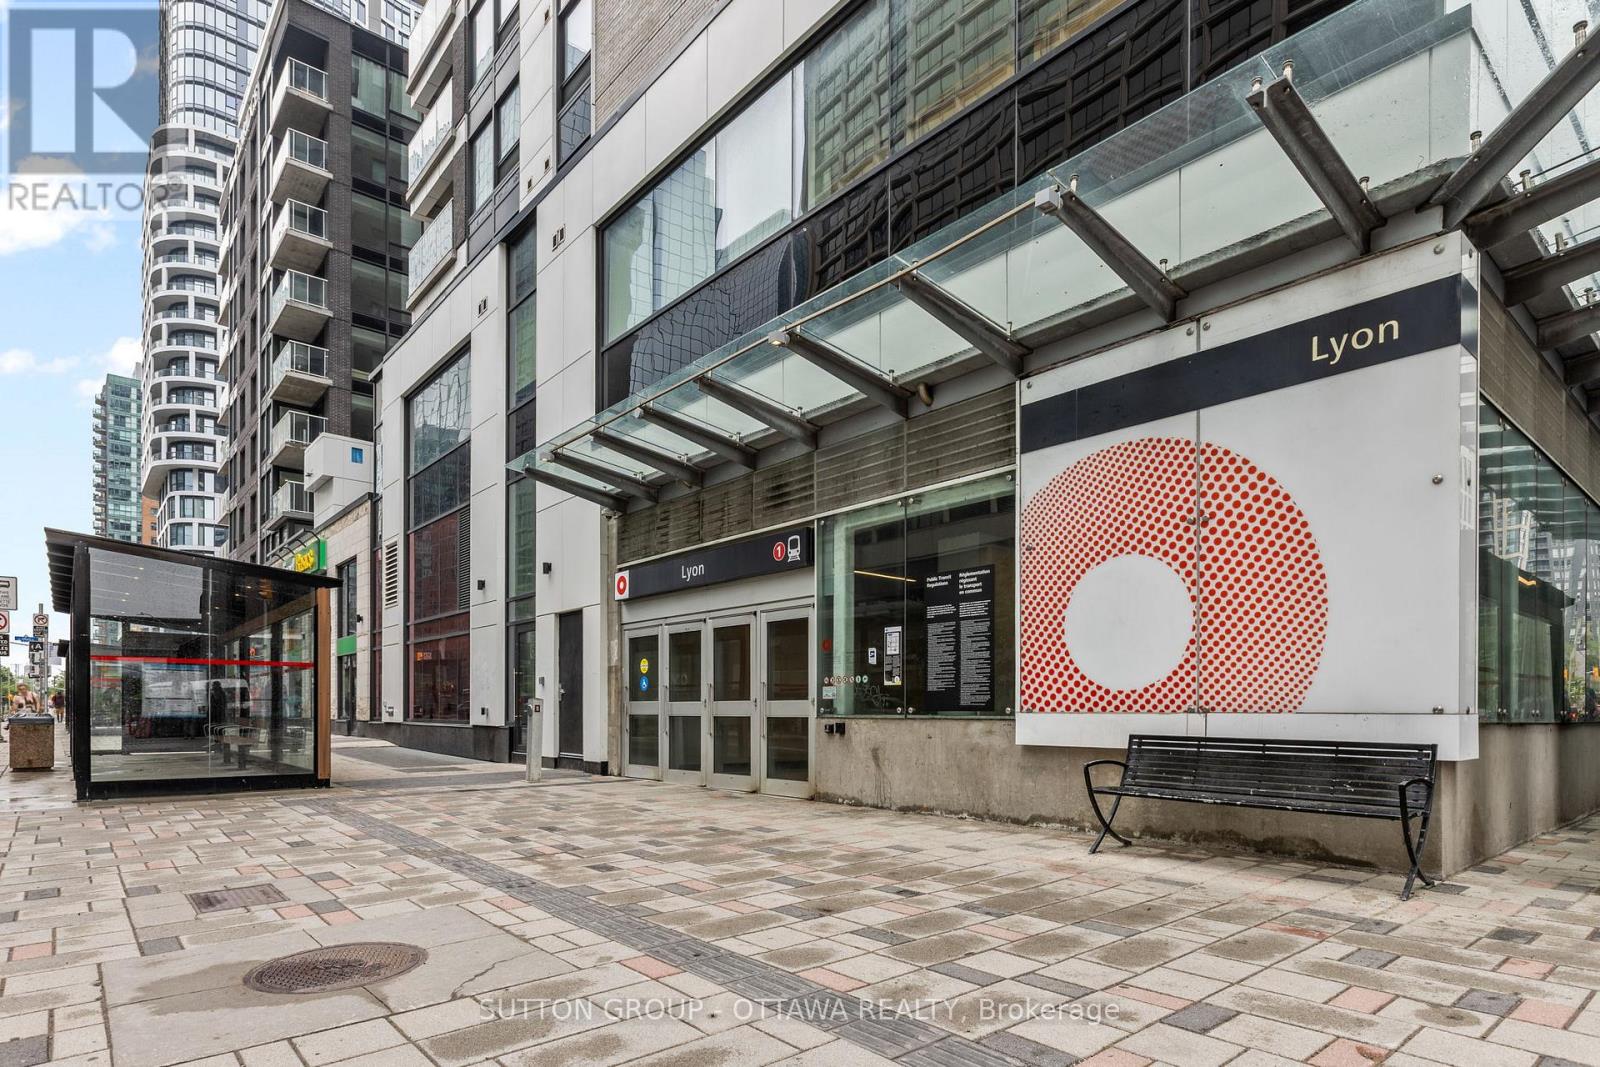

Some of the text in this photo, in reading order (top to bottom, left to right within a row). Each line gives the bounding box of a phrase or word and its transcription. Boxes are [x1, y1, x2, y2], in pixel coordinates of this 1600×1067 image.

[1311, 319, 1399, 365] Lyon
[775, 546, 782, 558] 1
[681, 563, 705, 582] Lyon
